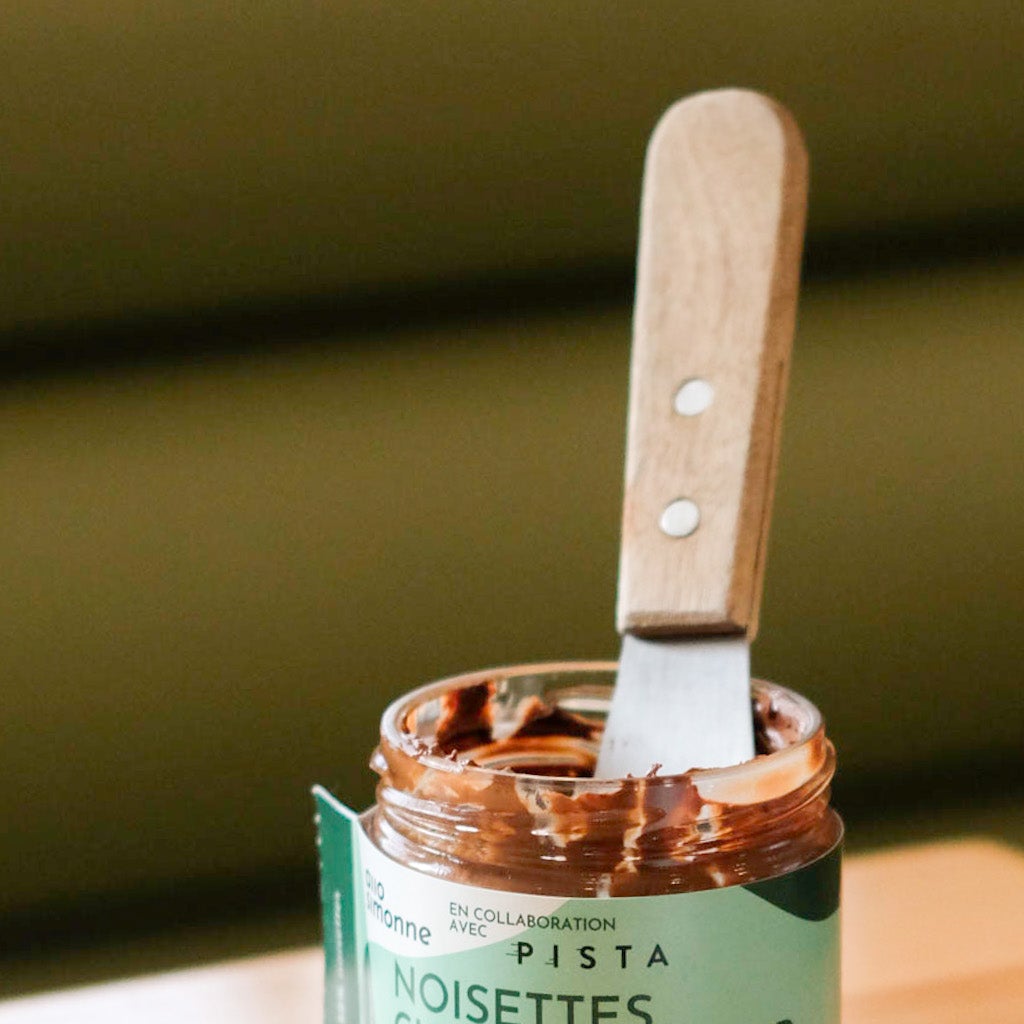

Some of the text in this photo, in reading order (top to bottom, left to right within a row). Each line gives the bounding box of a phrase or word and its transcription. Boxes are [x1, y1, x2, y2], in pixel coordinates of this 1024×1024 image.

[450, 903, 615, 930] EN COLLABORATION
[450, 921, 487, 937] AVEC
[507, 941, 669, 969] PISTA
